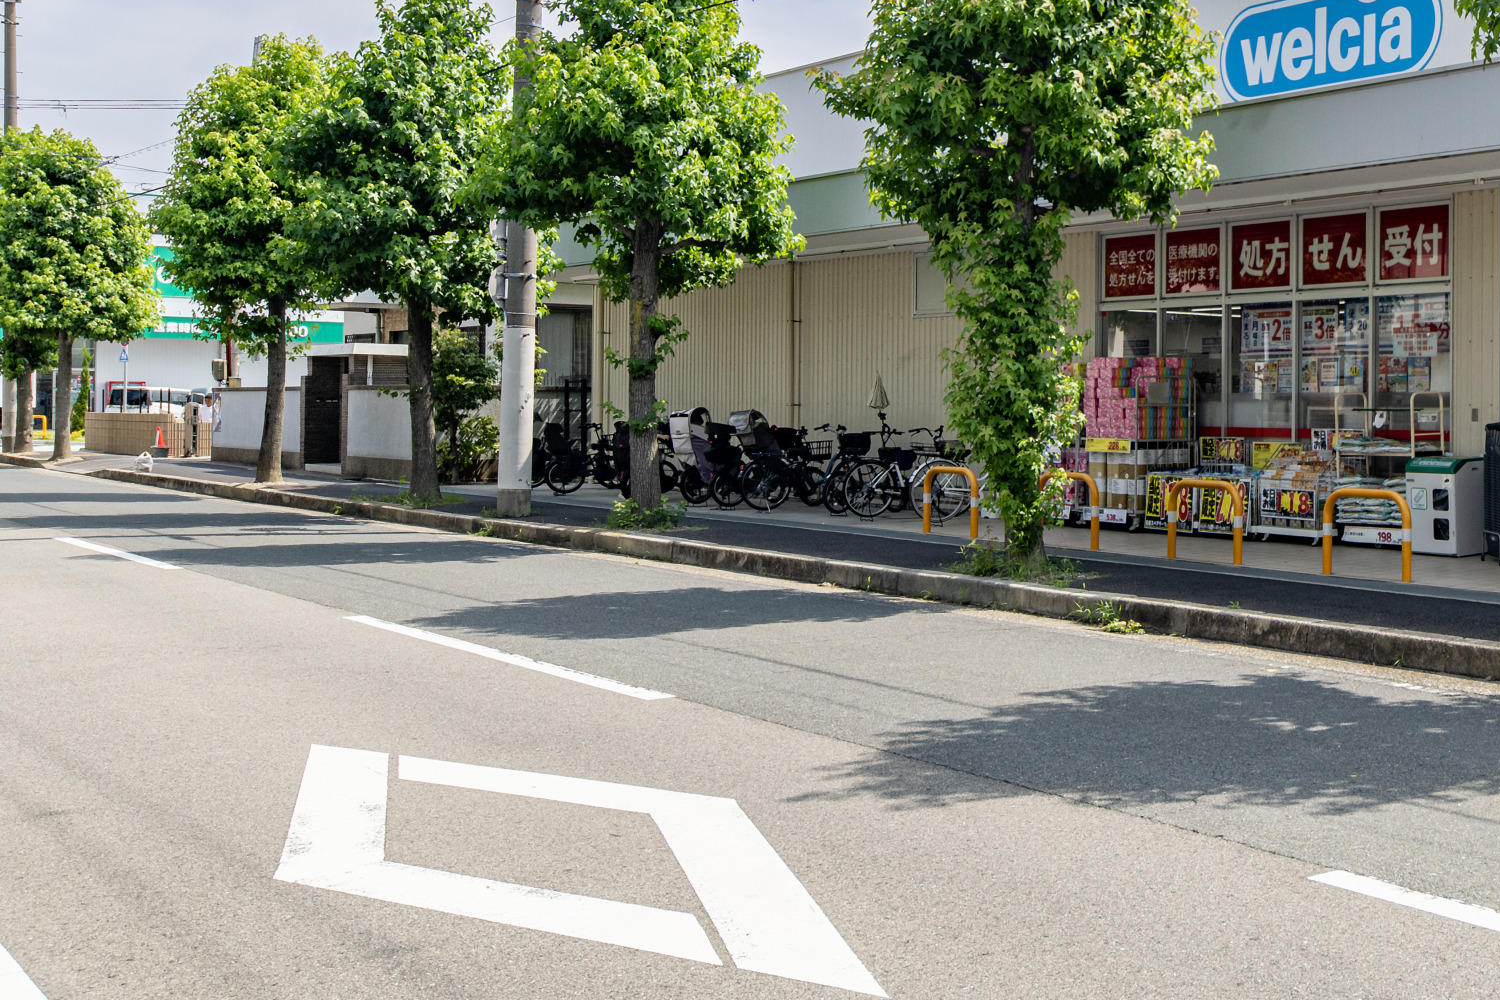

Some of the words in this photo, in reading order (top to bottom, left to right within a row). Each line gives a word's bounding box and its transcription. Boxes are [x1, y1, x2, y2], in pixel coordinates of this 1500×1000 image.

[1240, 6, 1412, 87] welcia
[1160, 479, 1189, 522] 18
[1276, 491, 1310, 514] 118
[1377, 531, 1392, 543] 198
